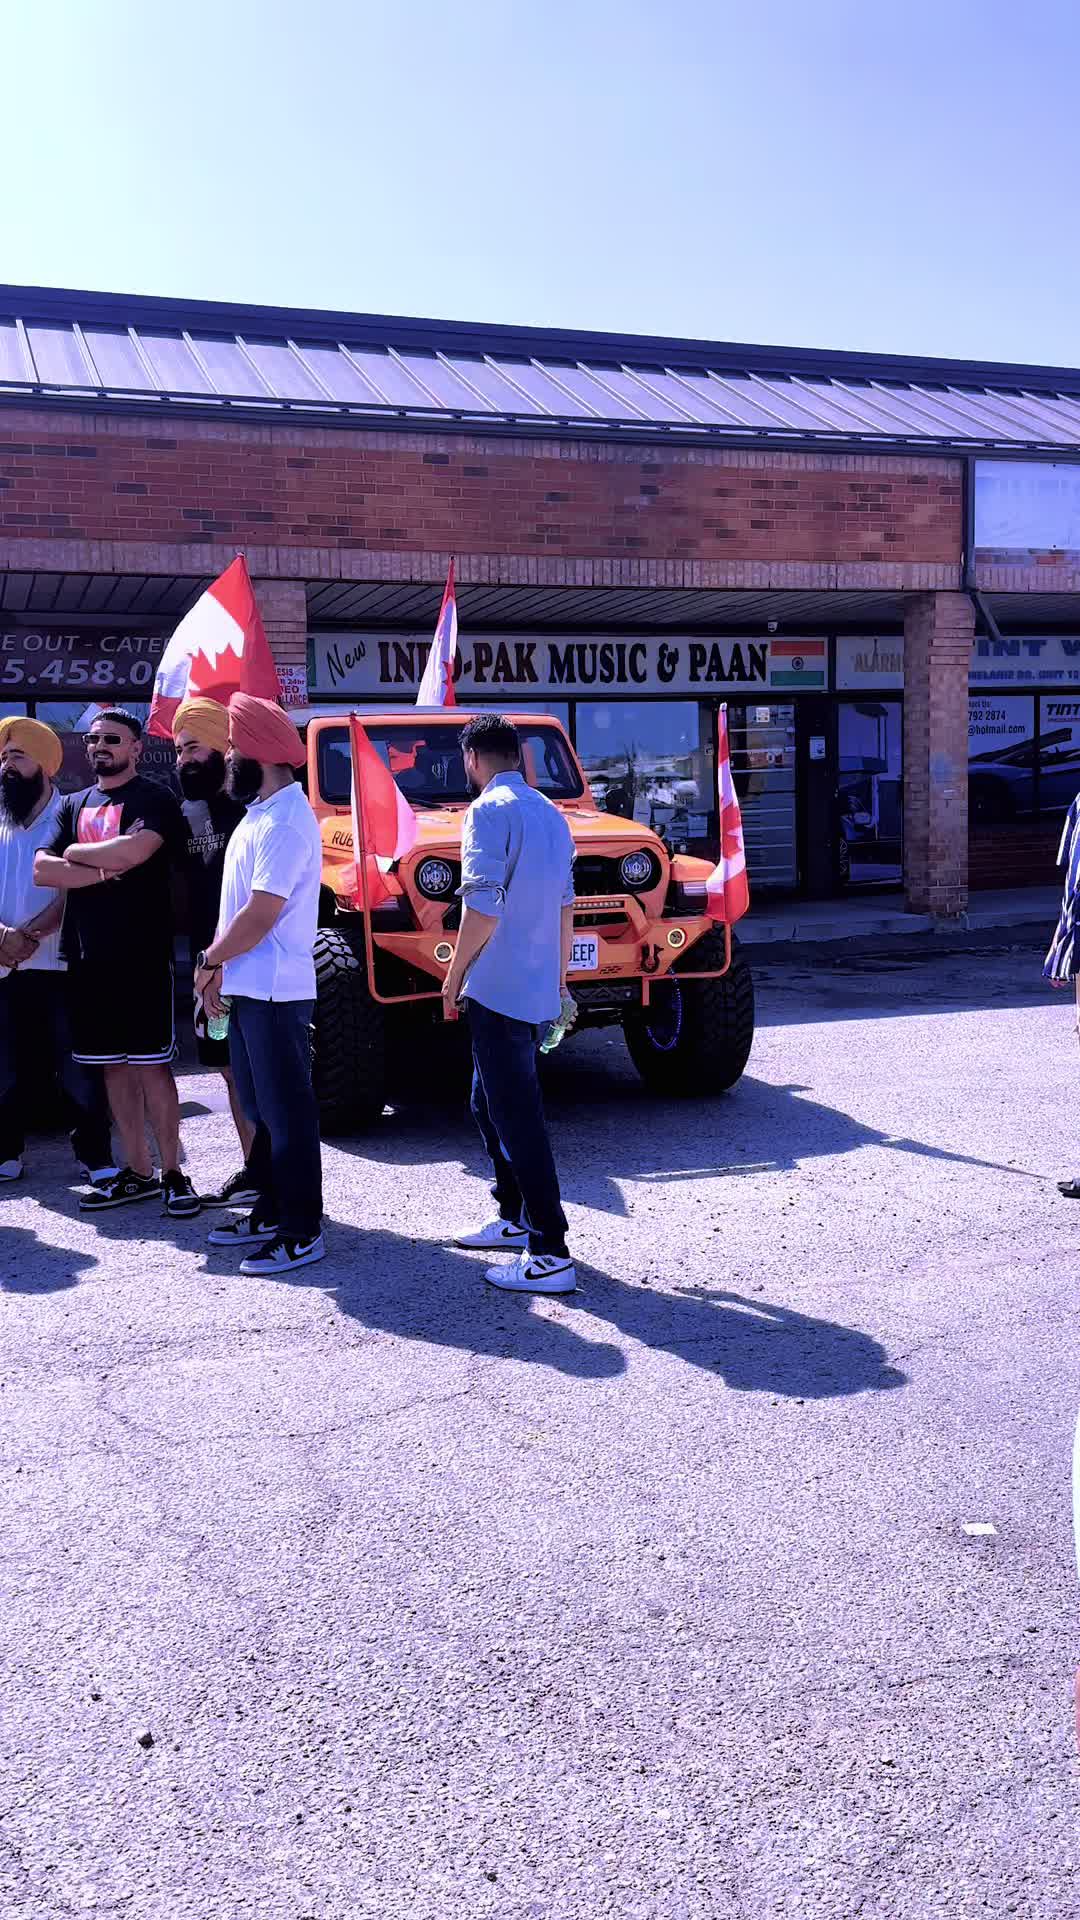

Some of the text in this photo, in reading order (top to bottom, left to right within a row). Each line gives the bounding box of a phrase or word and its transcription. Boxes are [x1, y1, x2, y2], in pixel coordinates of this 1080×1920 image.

[23, 635, 80, 651] OUT
[326, 640, 366, 686] New
[548, 643, 647, 684] MUSIC
[657, 642, 679, 683] &
[689, 643, 767, 683] PAAN
[968, 710, 1006, 721] 792 2874
